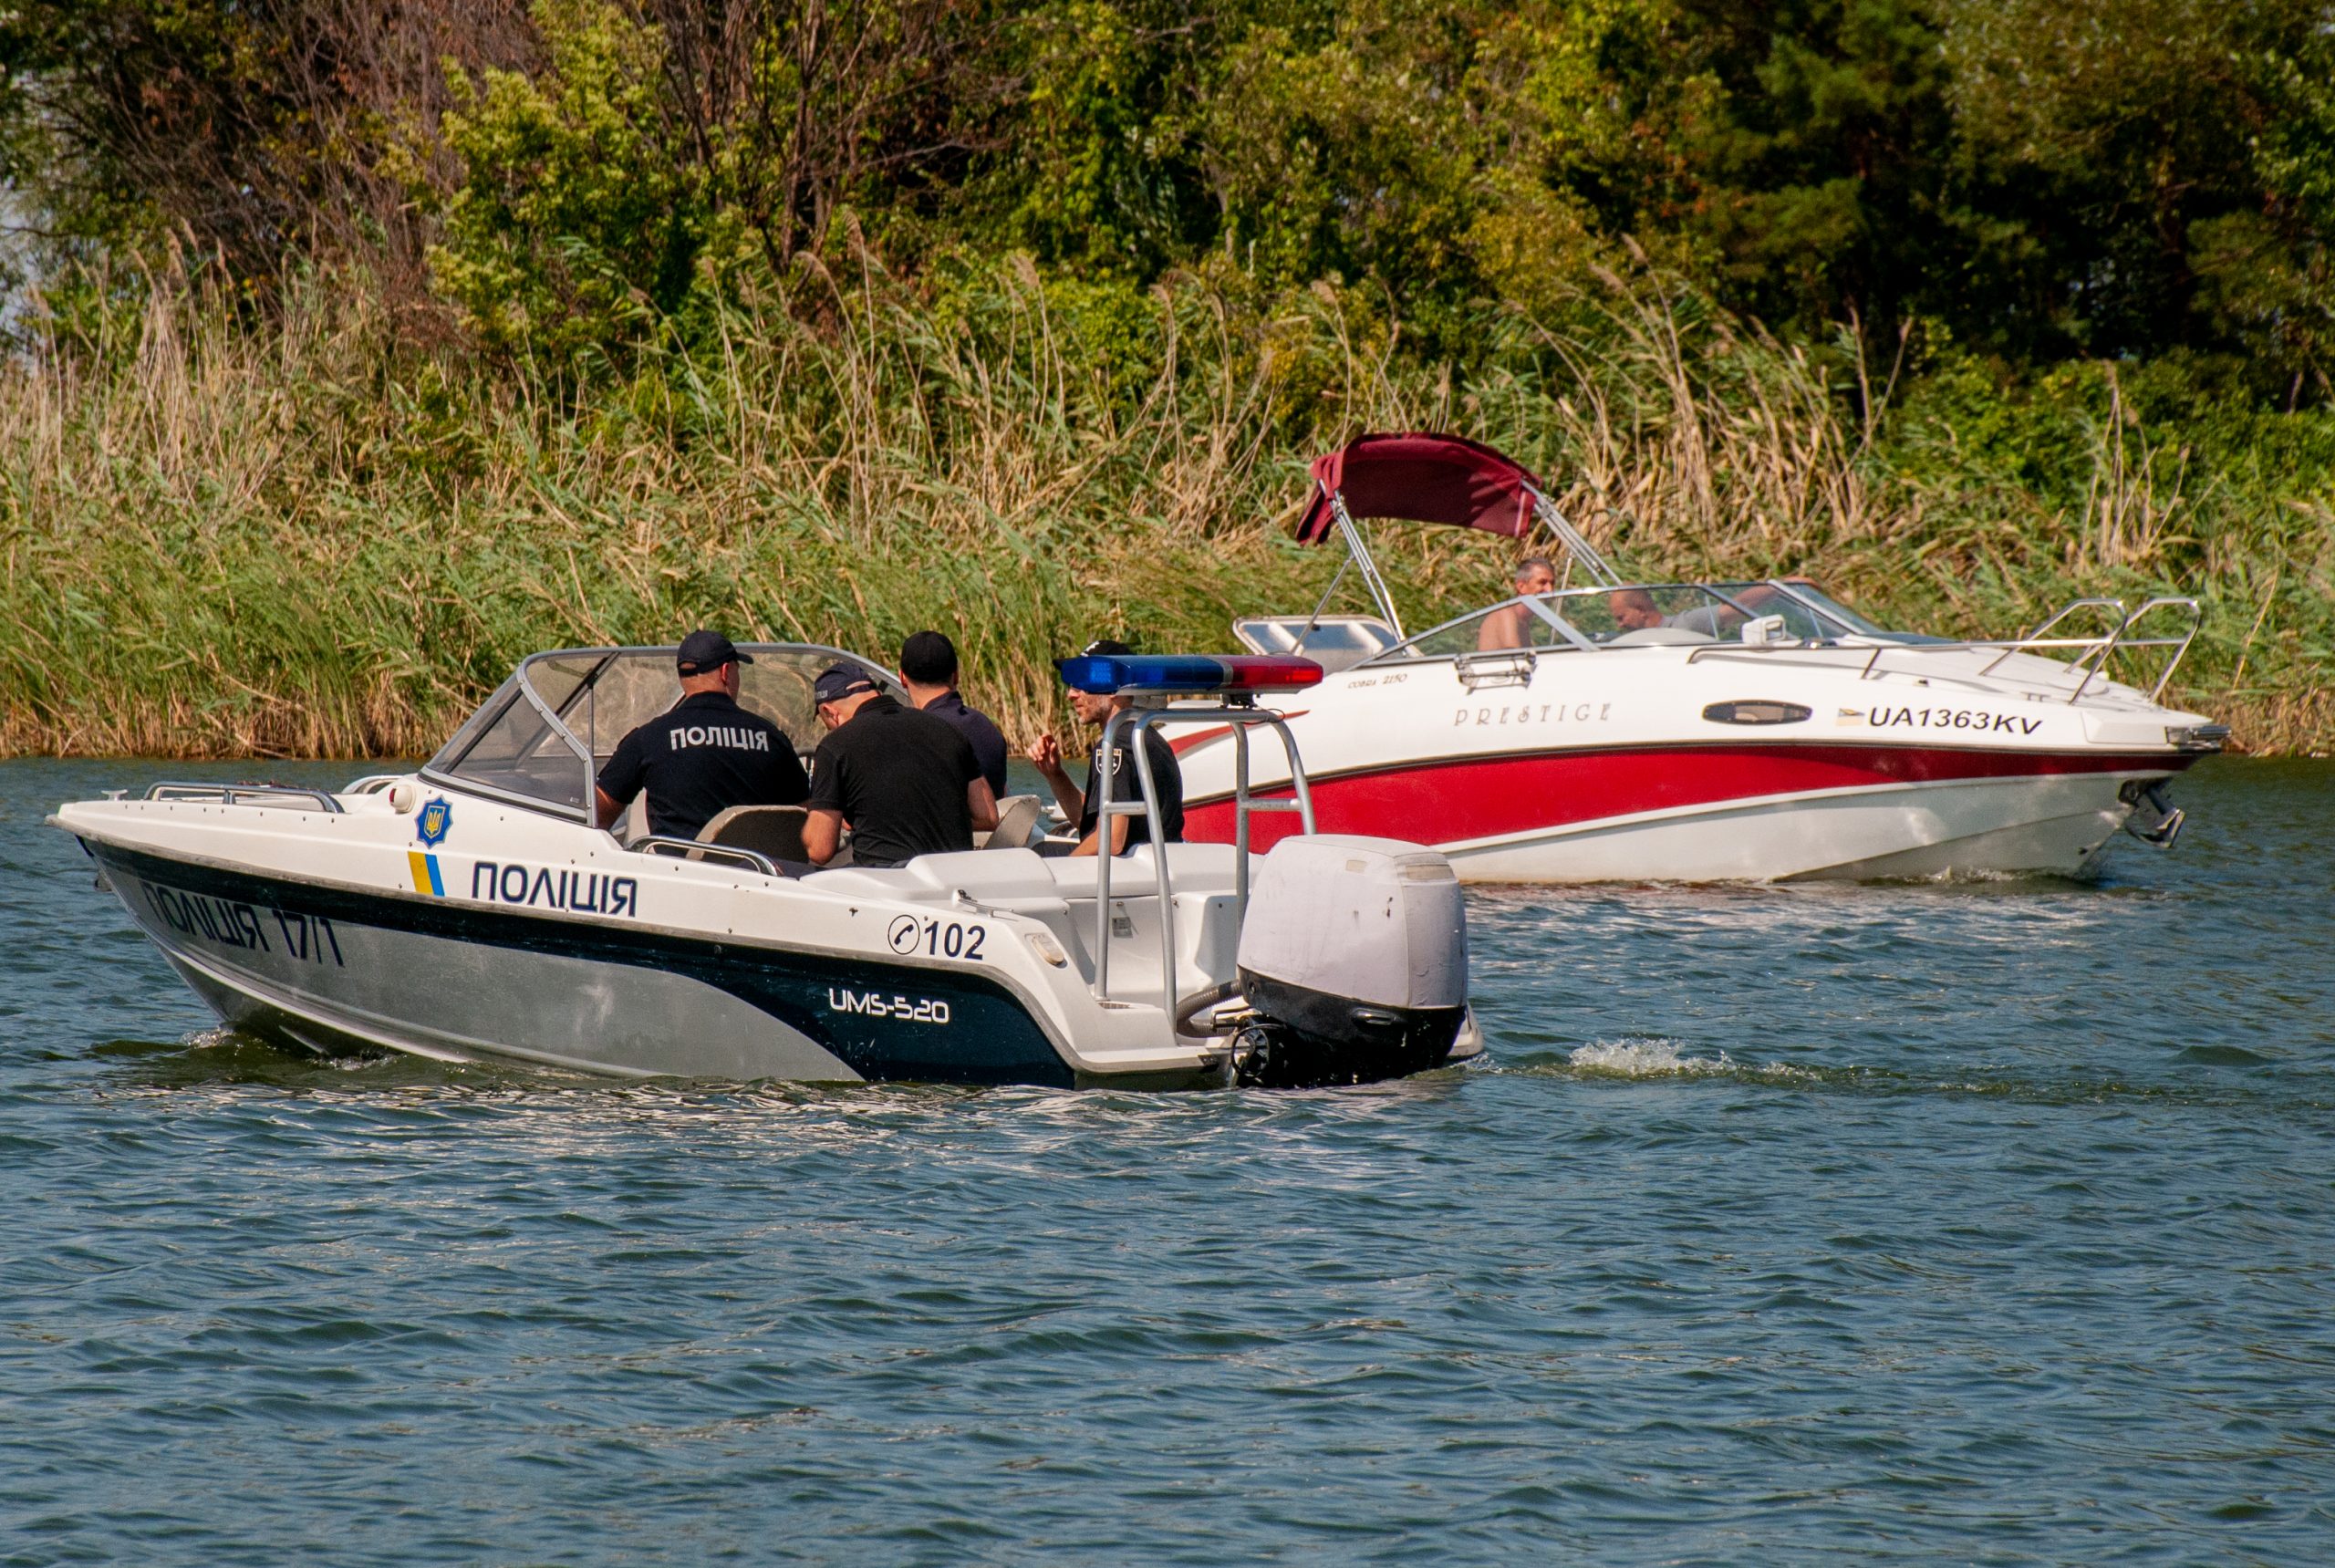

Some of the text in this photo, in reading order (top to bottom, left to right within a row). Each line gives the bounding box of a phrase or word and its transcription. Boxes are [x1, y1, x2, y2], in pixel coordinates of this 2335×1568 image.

[1454, 703, 1611, 726] PRESTIGE
[1870, 707, 2043, 734] UA1363KV
[670, 726, 769, 752] ПОЛІЦІЯ
[472, 860, 638, 918] ПОЛІЦІЯ
[140, 880, 271, 952] ПОЛІЦІЯ
[924, 920, 986, 961] 102
[828, 988, 950, 1023] UMS-520
